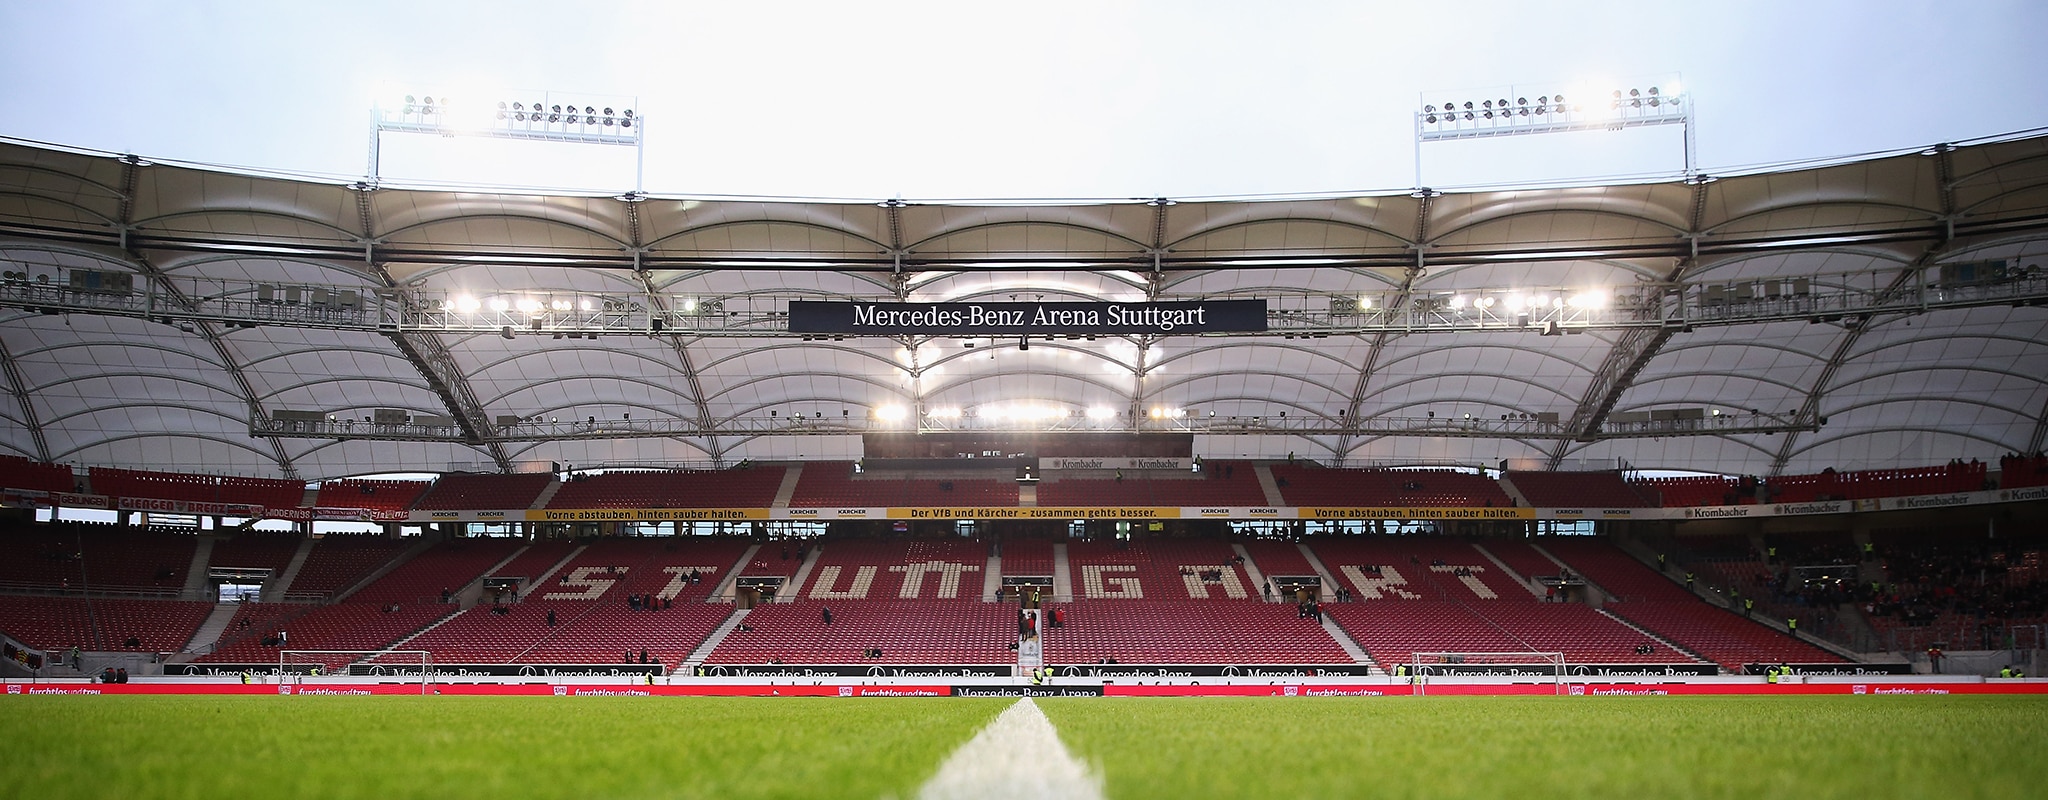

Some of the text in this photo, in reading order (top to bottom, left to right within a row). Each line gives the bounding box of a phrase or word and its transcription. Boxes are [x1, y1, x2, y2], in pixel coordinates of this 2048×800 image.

[853, 304, 1206, 331] Mercedes-Benz Arena Stuttgart
[1062, 459, 1103, 469] Krombacher
[1138, 459, 1179, 469] Krombacher
[61, 493, 107, 506] GERLINGEN
[1907, 495, 1969, 508] Krombacher
[121, 498, 174, 510] GIENGEN
[187, 502, 225, 513] BRENZ
[1783, 504, 1840, 514] Krombacher
[546, 510, 747, 520] Vorne abstauben, hinten sauber halten.
[933, 509, 951, 517] VfB
[955, 509, 974, 517] und
[977, 509, 1018, 517] Kärcher
[1088, 509, 1116, 518] gehts
[1120, 509, 1157, 517] besser.
[1315, 509, 1519, 518] Vorne abstauben, hinten sauber halten.
[1694, 508, 1748, 518] Krombacher
[958, 687, 1097, 697] Mercedes-Benz Arena
